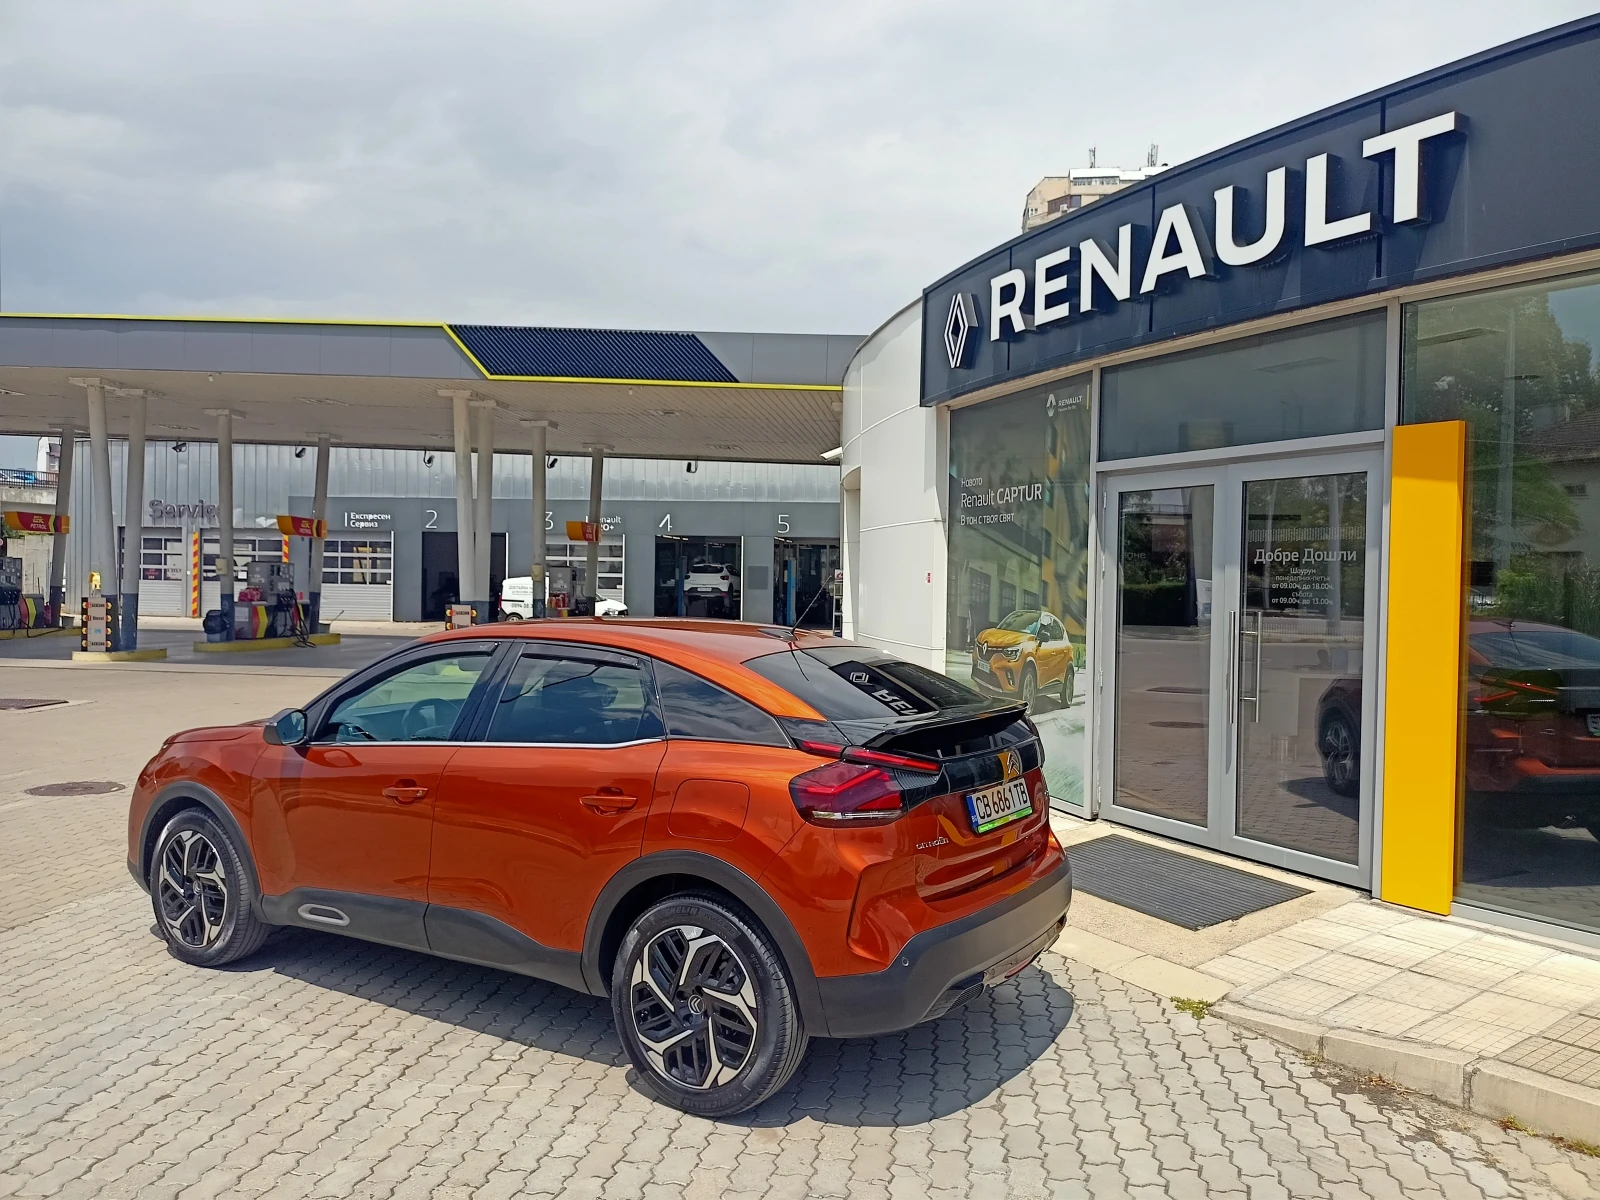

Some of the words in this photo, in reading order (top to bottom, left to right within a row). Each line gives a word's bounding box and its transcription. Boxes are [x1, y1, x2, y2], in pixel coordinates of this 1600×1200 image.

[990, 111, 1457, 342] RENAULT
[1058, 395, 1083, 407] RENAULT
[961, 477, 983, 488] Новото
[961, 489, 995, 508] Renault
[996, 483, 1042, 504] CAPTUR
[149, 499, 219, 519] Servic
[350, 512, 391, 521] Експресен
[350, 520, 379, 529] Сервиз
[425, 509, 438, 529] 2
[544, 511, 554, 530] 3
[658, 513, 673, 532] 4
[777, 514, 790, 534] 5
[960, 514, 966, 526] В
[966, 516, 978, 525] тон
[983, 514, 999, 524] твоя
[999, 513, 1015, 523] свят
[1254, 548, 1299, 565] Добре
[1302, 548, 1357, 565] Дошли
